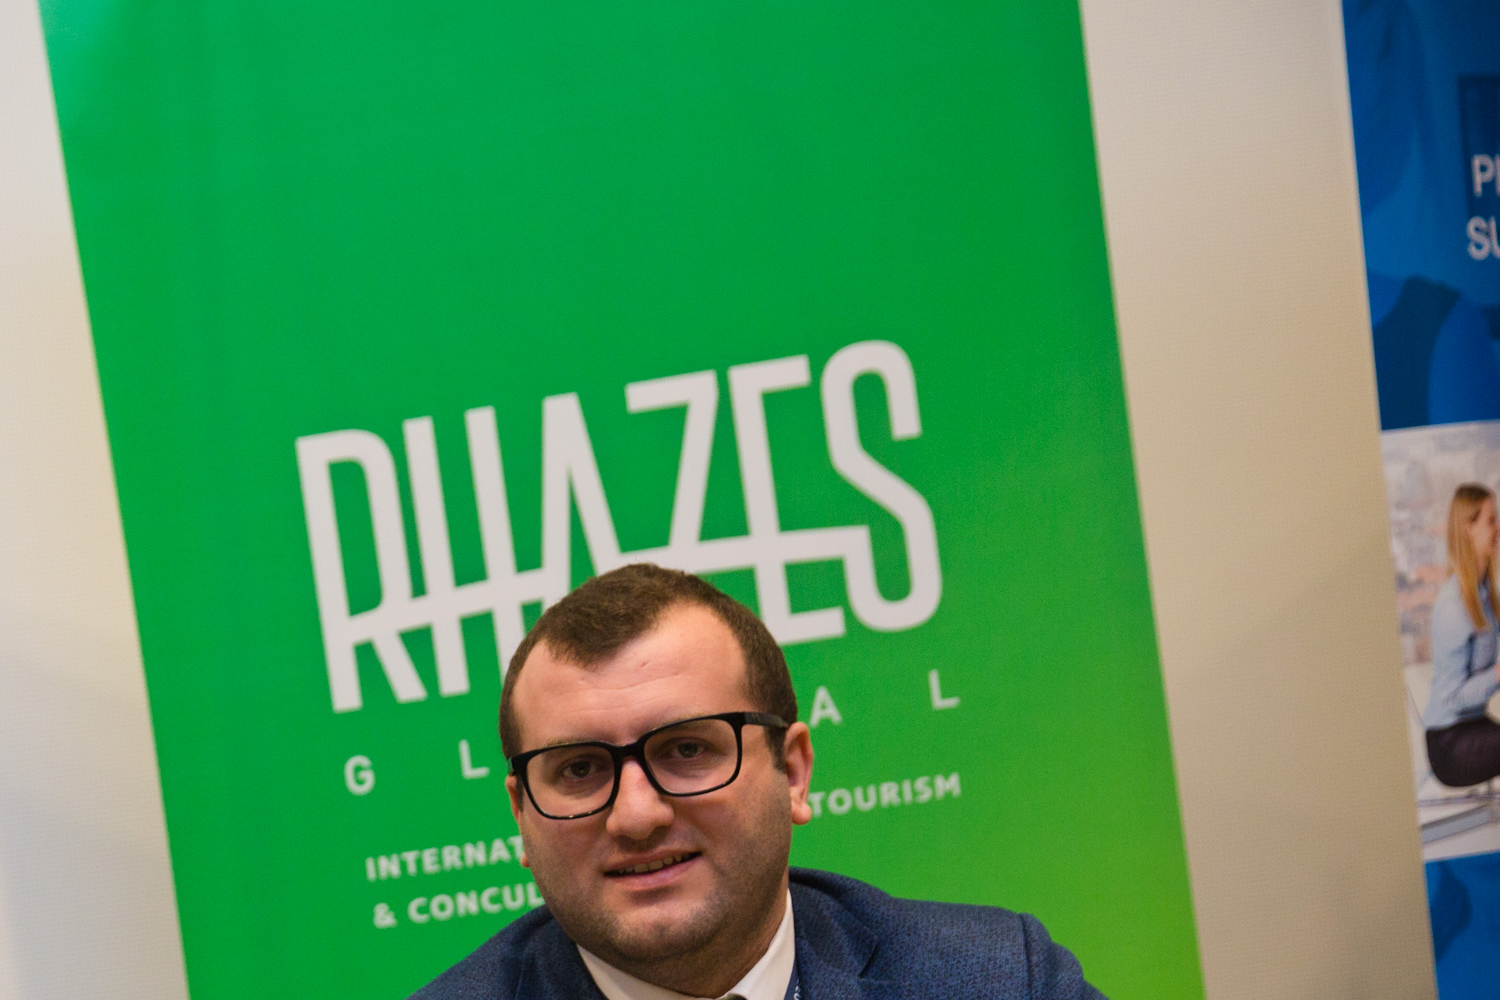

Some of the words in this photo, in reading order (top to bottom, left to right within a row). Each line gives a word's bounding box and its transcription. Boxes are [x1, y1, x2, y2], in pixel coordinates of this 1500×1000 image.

[296, 339, 943, 714] RHAZES
[365, 835, 525, 882] INTERNAT
[808, 772, 962, 817] TOURISM
[373, 903, 397, 929] &
[407, 882, 545, 924] CONCUL
